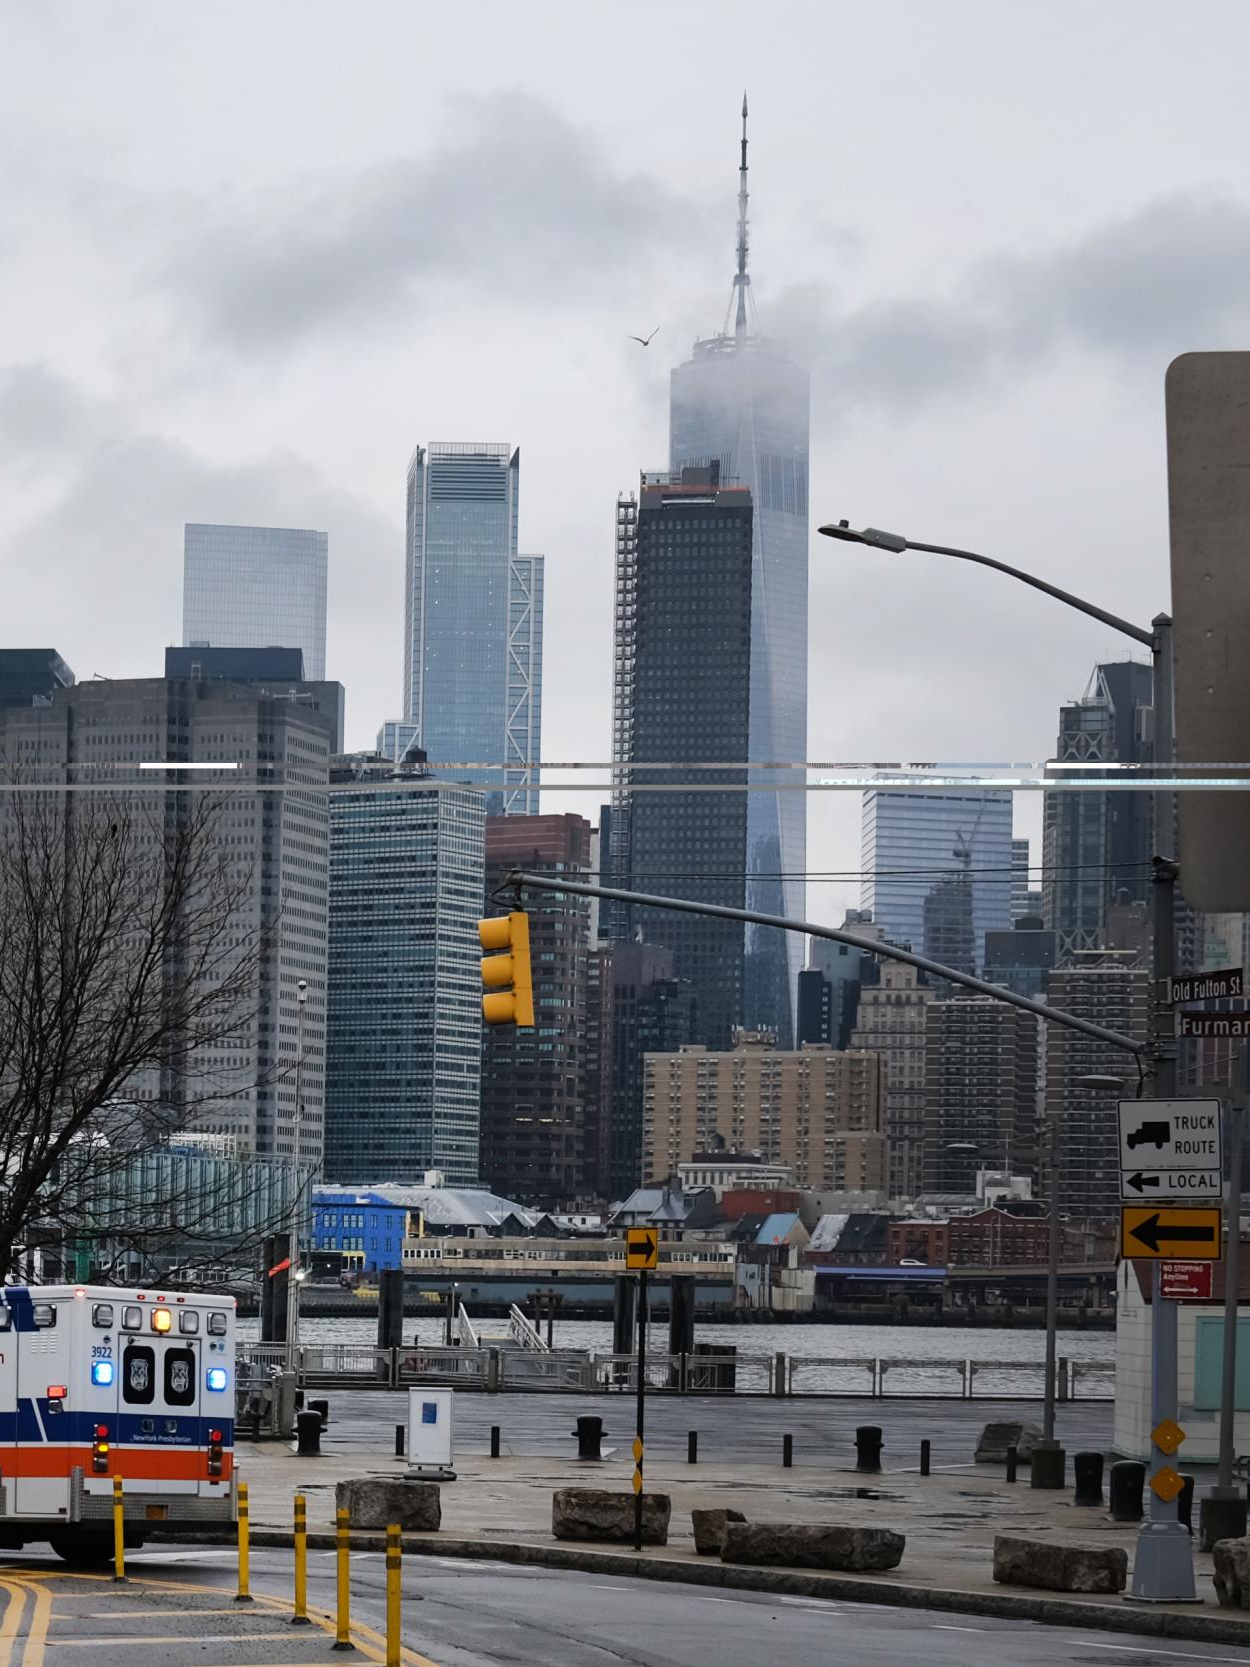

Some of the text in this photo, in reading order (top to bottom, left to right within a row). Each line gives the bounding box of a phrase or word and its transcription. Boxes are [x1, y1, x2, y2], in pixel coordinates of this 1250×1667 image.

[1173, 976, 1240, 1001] Old Fulton St
[1174, 1116, 1215, 1130] TRUCK
[1175, 1141, 1215, 1154] ROUTE
[1169, 1175, 1217, 1188] LOCAL
[91, 1346, 112, 1358] 3922
